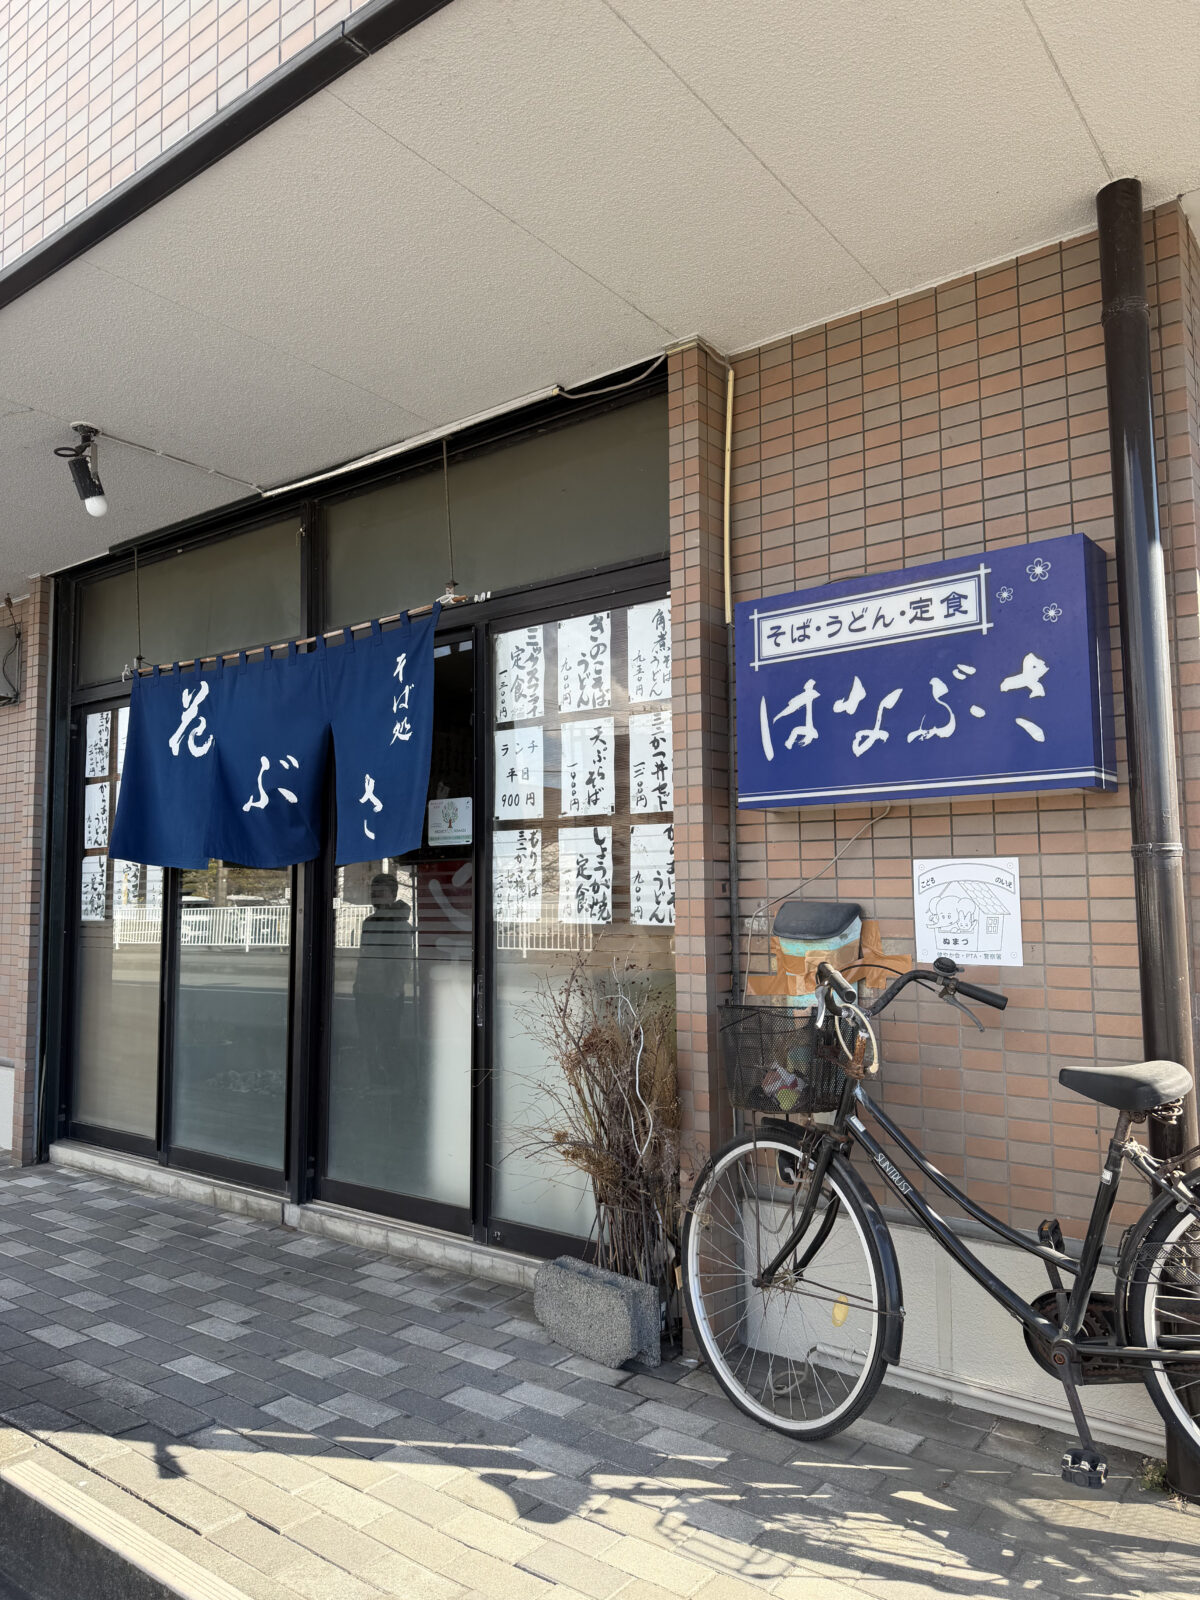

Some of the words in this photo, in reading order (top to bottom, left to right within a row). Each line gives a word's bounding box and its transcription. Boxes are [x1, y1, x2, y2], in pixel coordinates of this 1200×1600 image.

[766, 591, 969, 647] そば・うどん・定食
[510, 645, 528, 703] 定食
[576, 652, 590, 709] うどん
[588, 614, 609, 707] きのこそば
[650, 655, 663, 698] うどん
[390, 653, 415, 746] そば処
[760, 652, 1050, 763] はなぶさ
[501, 740, 539, 757] ランチ
[506, 767, 530, 783] 平日
[590, 726, 608, 781] 天ぷら
[585, 770, 605, 806] そば
[526, 829, 541, 898] もりそば
[575, 854, 593, 914] 定食
[649, 870, 665, 924] うどん
[873, 1152, 914, 1195] SUNTRUST
